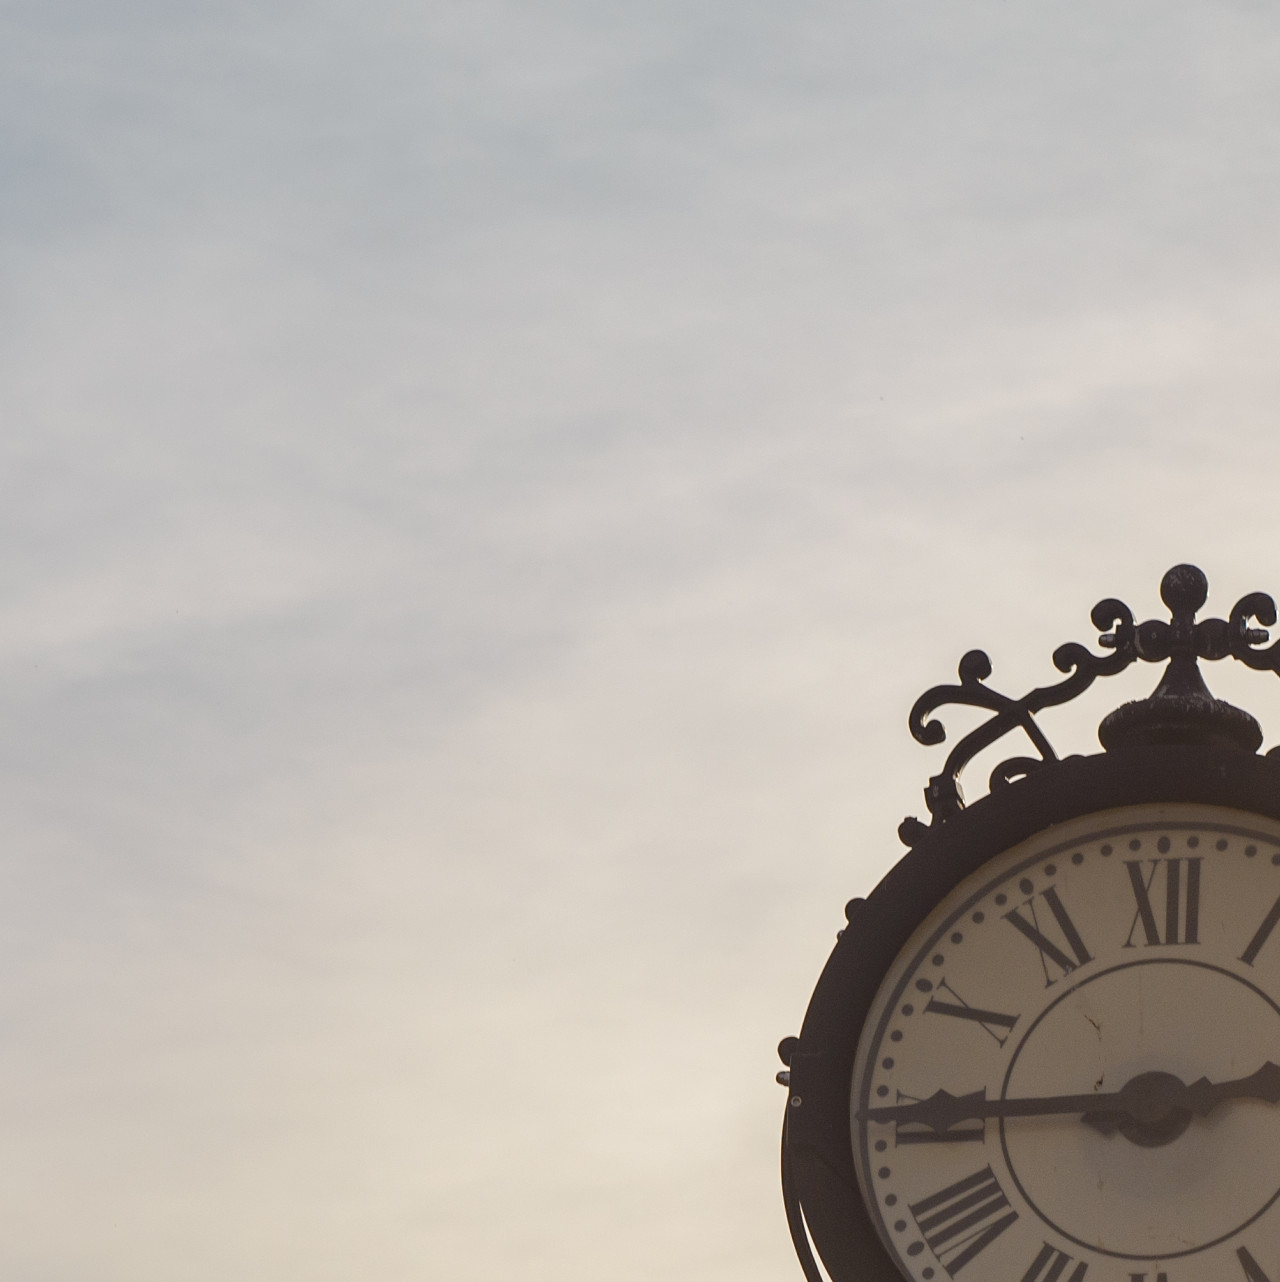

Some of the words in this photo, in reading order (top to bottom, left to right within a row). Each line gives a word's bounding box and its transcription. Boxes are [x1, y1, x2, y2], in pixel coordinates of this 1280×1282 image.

[1002, 884, 1096, 989] XI
[1123, 857, 1204, 948] XII
[923, 979, 1022, 1049] X
[895, 1086, 987, 1147] I
[907, 1163, 1020, 1277] VIII
